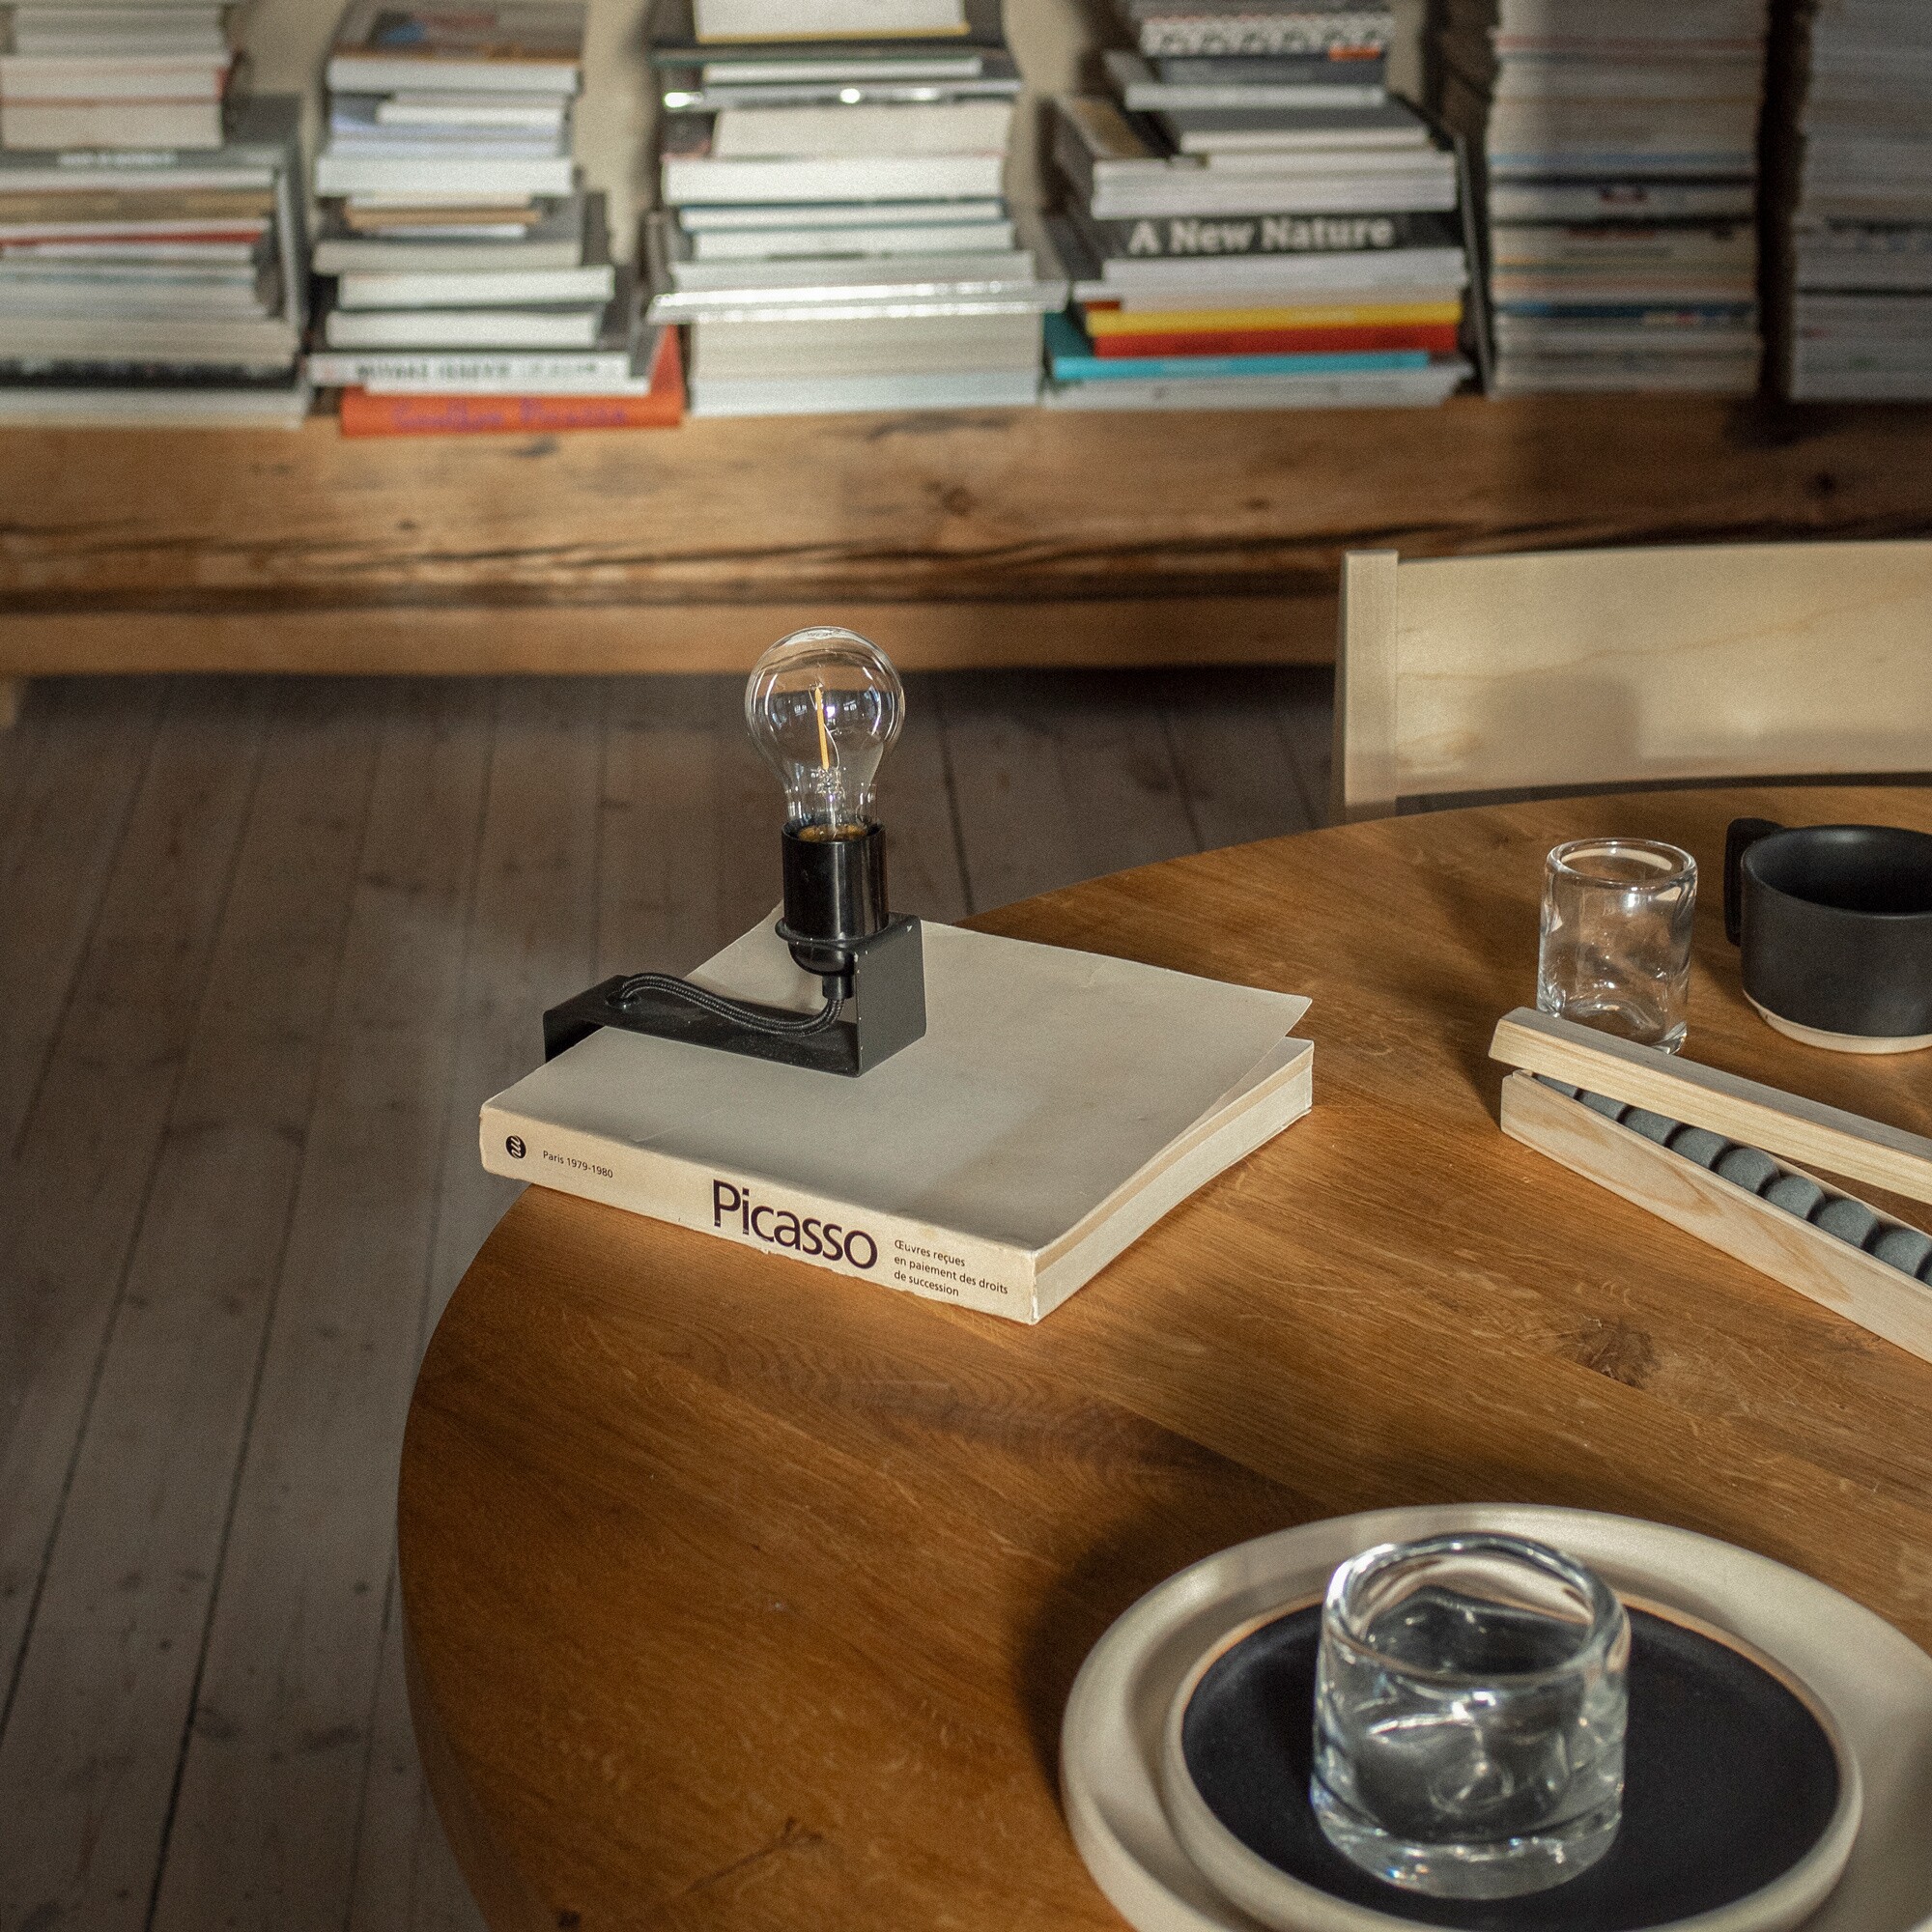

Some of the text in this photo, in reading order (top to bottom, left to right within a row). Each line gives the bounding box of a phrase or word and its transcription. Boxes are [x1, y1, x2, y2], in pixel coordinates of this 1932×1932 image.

[1128, 216, 1394, 254] A New Nature
[543, 1150, 613, 1179] Paris 1979-1980
[712, 1179, 879, 1270] Picasso
[894, 1239, 966, 1267] Œuvres reçues
[894, 1256, 1009, 1294] en paiement des droits
[894, 1270, 959, 1297] de succession
